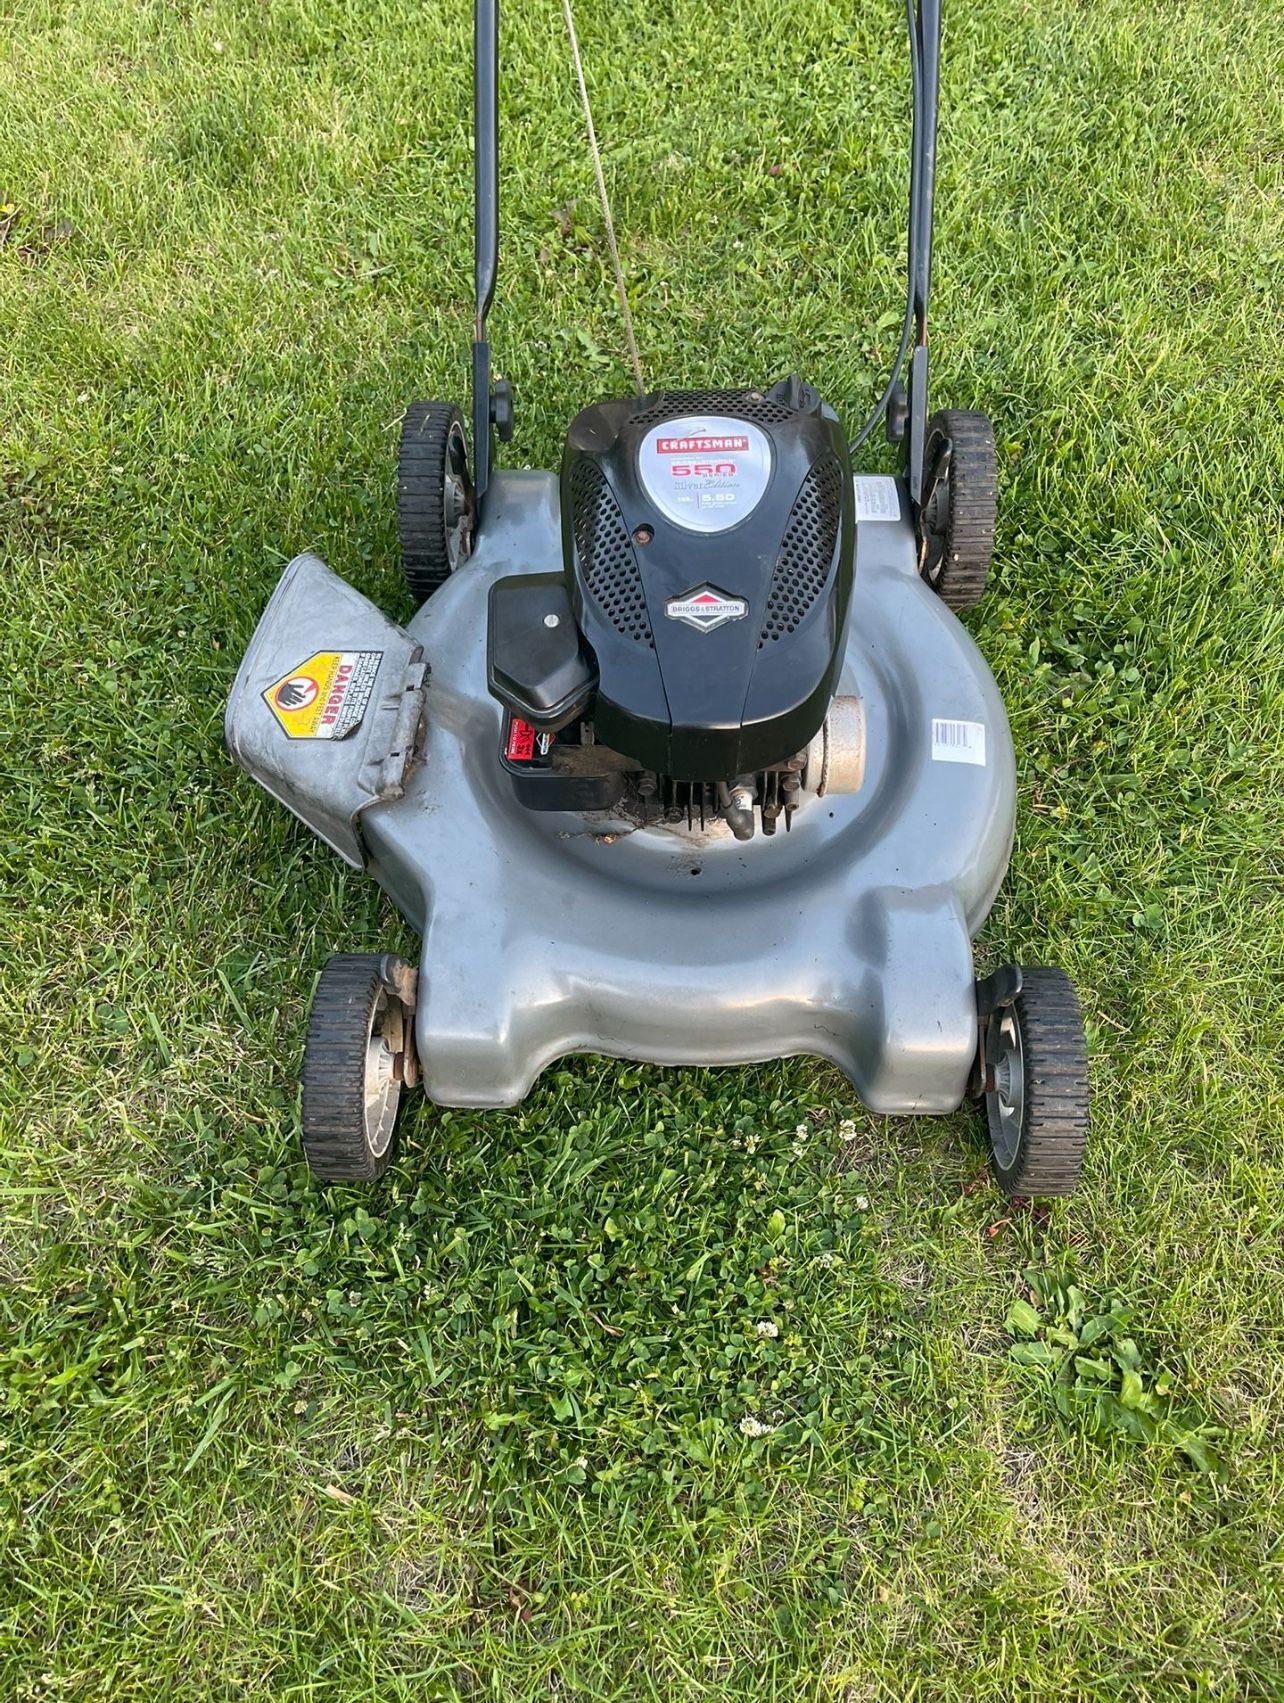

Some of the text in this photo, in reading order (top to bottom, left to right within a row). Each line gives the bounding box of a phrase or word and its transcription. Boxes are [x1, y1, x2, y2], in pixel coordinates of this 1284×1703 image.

[661, 438, 743, 450] CRAFTSMAN
[671, 463, 736, 476] 550
[320, 665, 353, 724] DANGER
